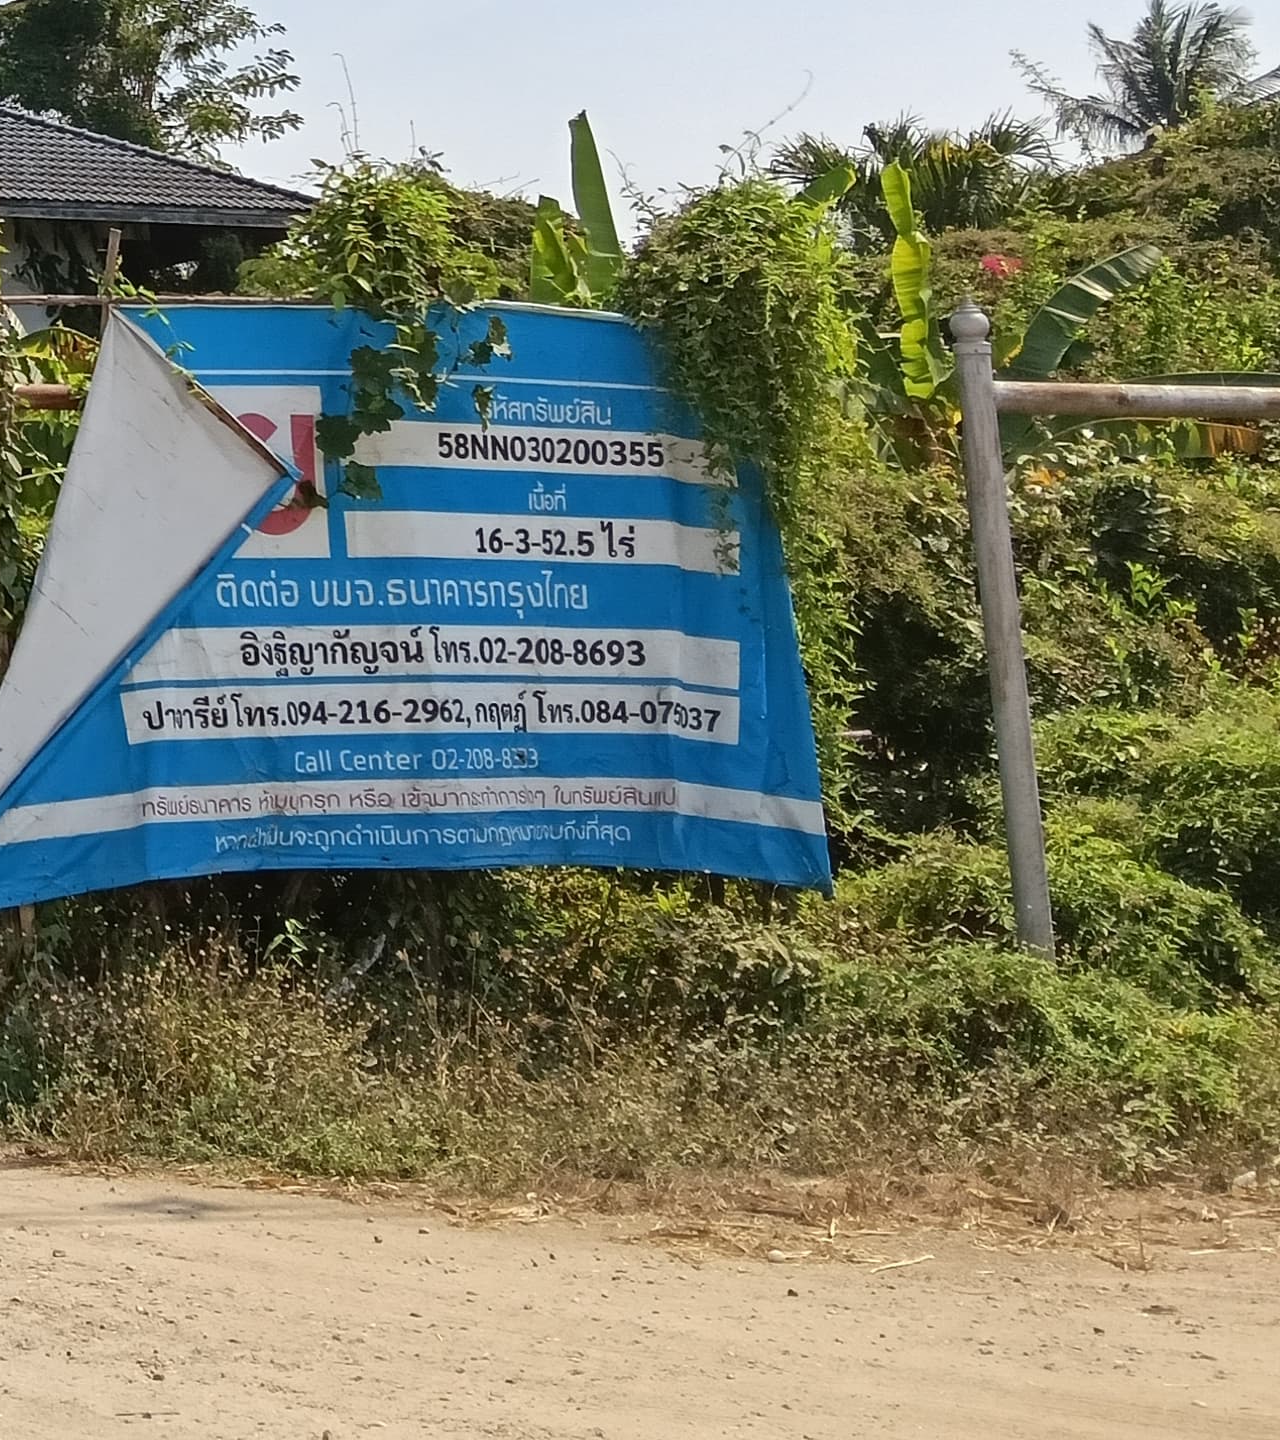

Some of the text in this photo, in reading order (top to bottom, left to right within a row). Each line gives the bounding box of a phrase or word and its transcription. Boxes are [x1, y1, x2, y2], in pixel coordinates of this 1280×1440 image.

[437, 431, 665, 467] 58NN030200355
[527, 481, 567, 510] เนื้อที่
[475, 520, 636, 558] 16-3-52.5 ไร่
[215, 569, 589, 620] ติดต่อ บมจ.ธนาคารกรุงไทย
[428, 626, 647, 666] โทร.02-208-8693
[294, 749, 333, 774] Call
[339, 749, 423, 772] Center
[141, 793, 252, 817] ทรัพย์ธนาคาร
[348, 787, 395, 809] หรือ
